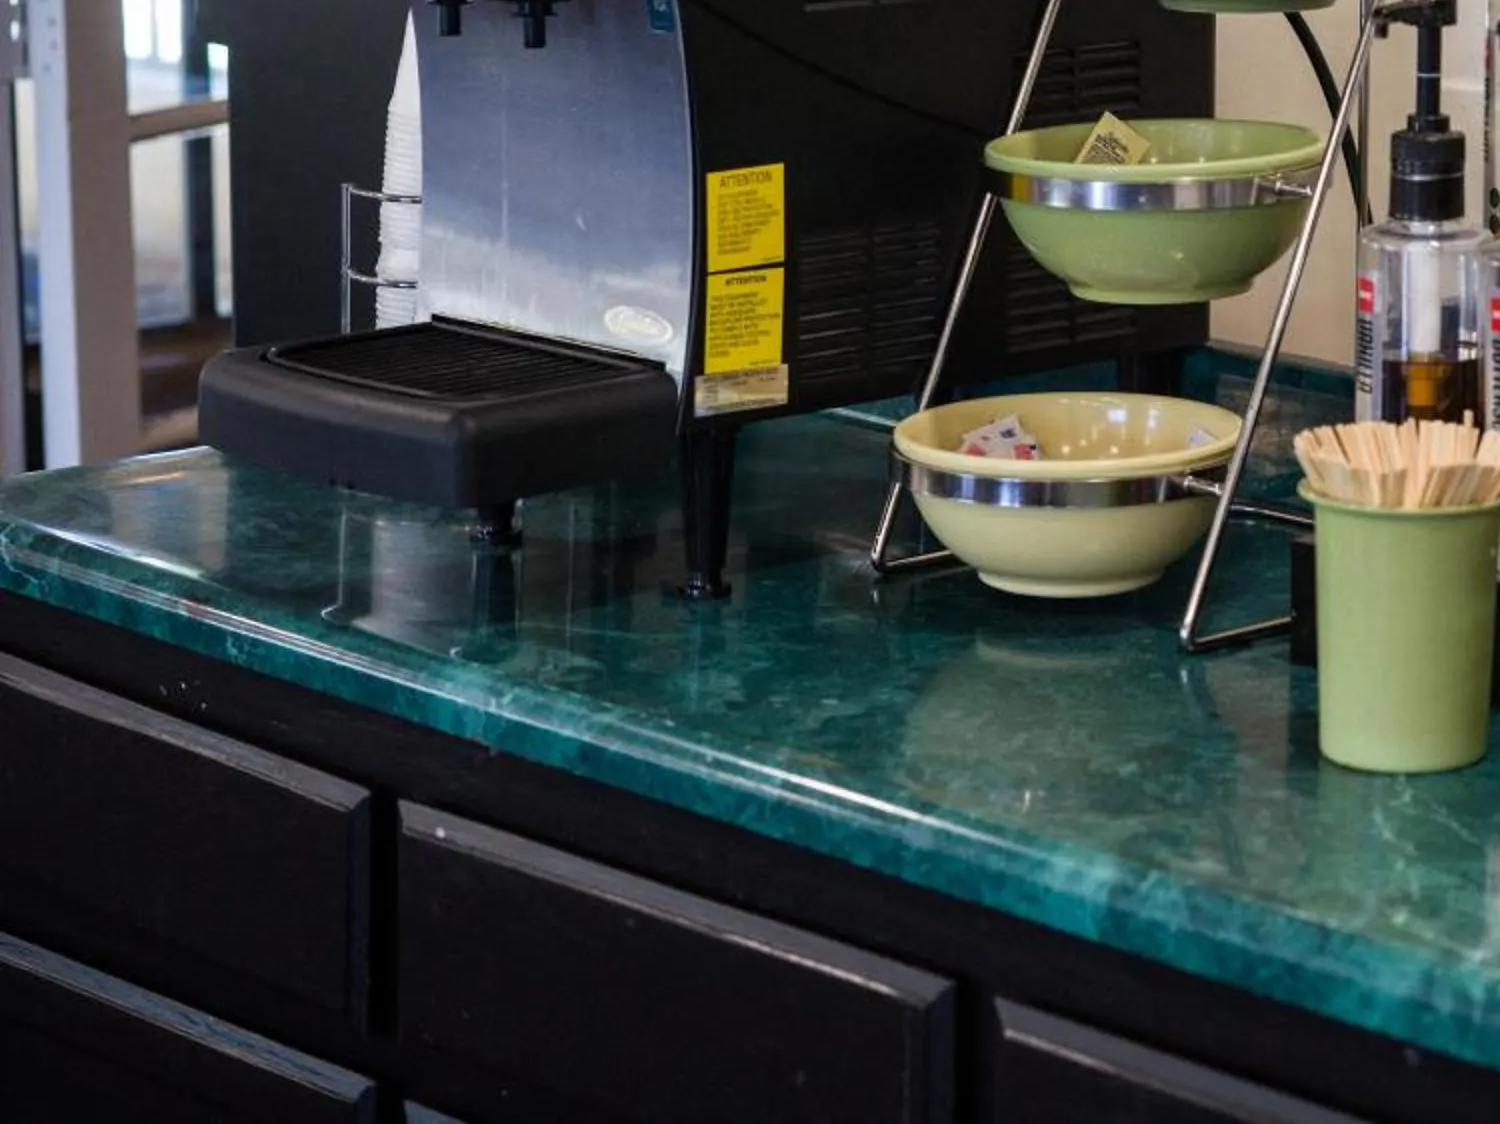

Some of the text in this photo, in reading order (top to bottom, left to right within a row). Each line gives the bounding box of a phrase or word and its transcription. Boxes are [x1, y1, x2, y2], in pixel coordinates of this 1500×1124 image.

[719, 170, 773, 188] ATTENTION
[725, 274, 767, 286] ATTENTION
[1356, 318, 1374, 394] VANILLA
